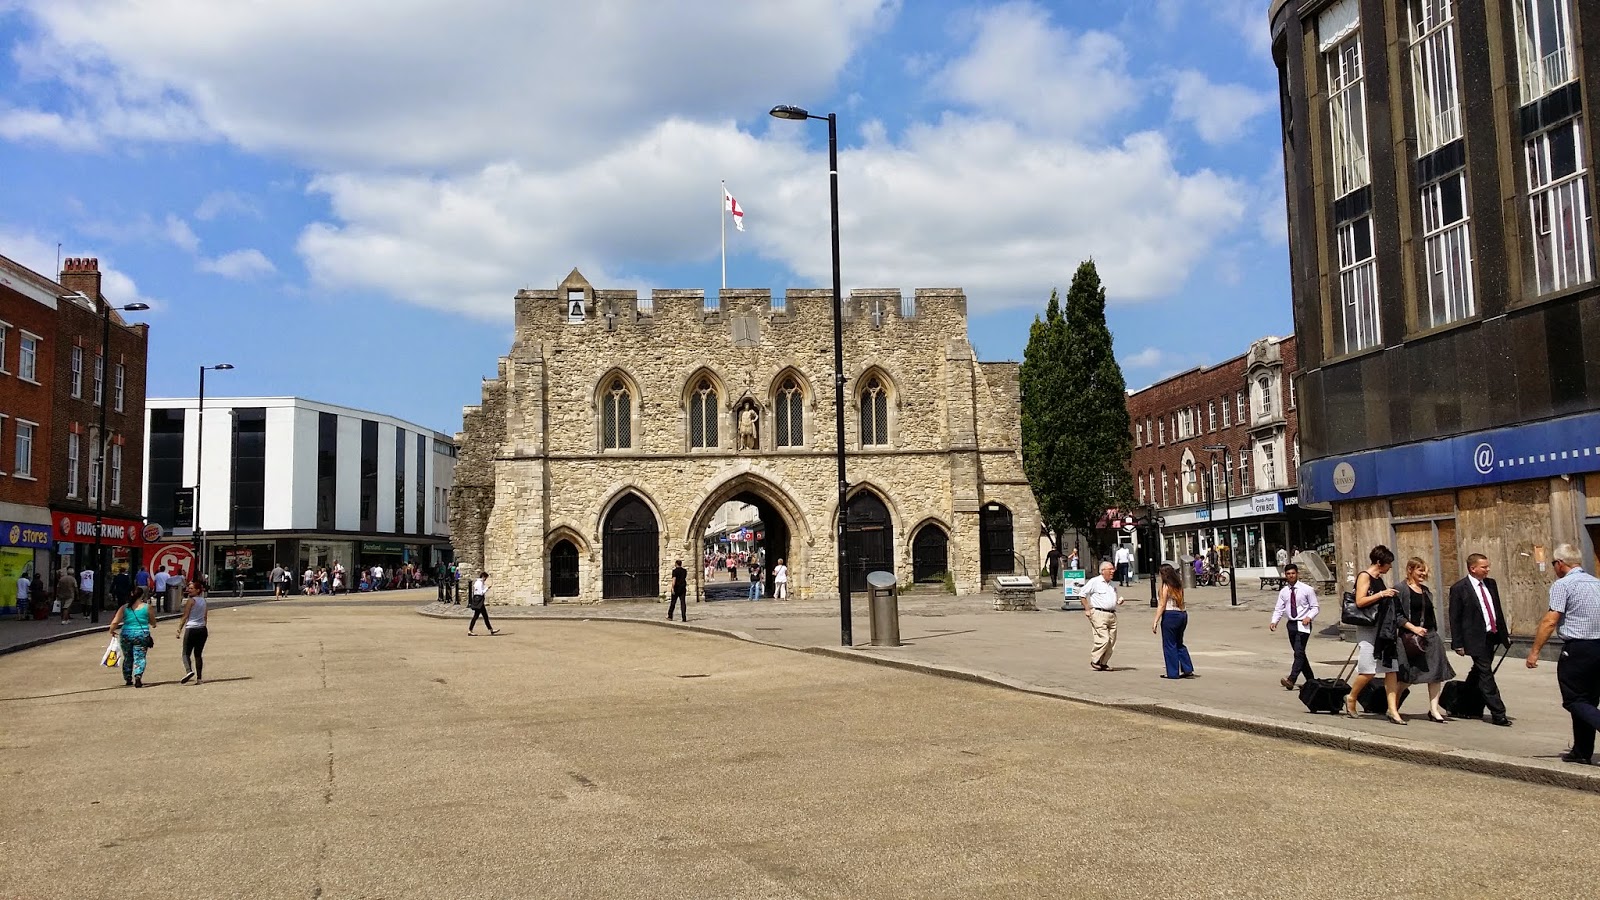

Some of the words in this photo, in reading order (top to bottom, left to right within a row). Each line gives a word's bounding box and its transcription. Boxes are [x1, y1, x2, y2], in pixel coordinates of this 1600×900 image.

[1285, 496, 1298, 505] LUSH
[22, 528, 48, 543] stores
[77, 522, 106, 537] BURGR
[107, 525, 124, 539] KING
[159, 554, 192, 580] £1
